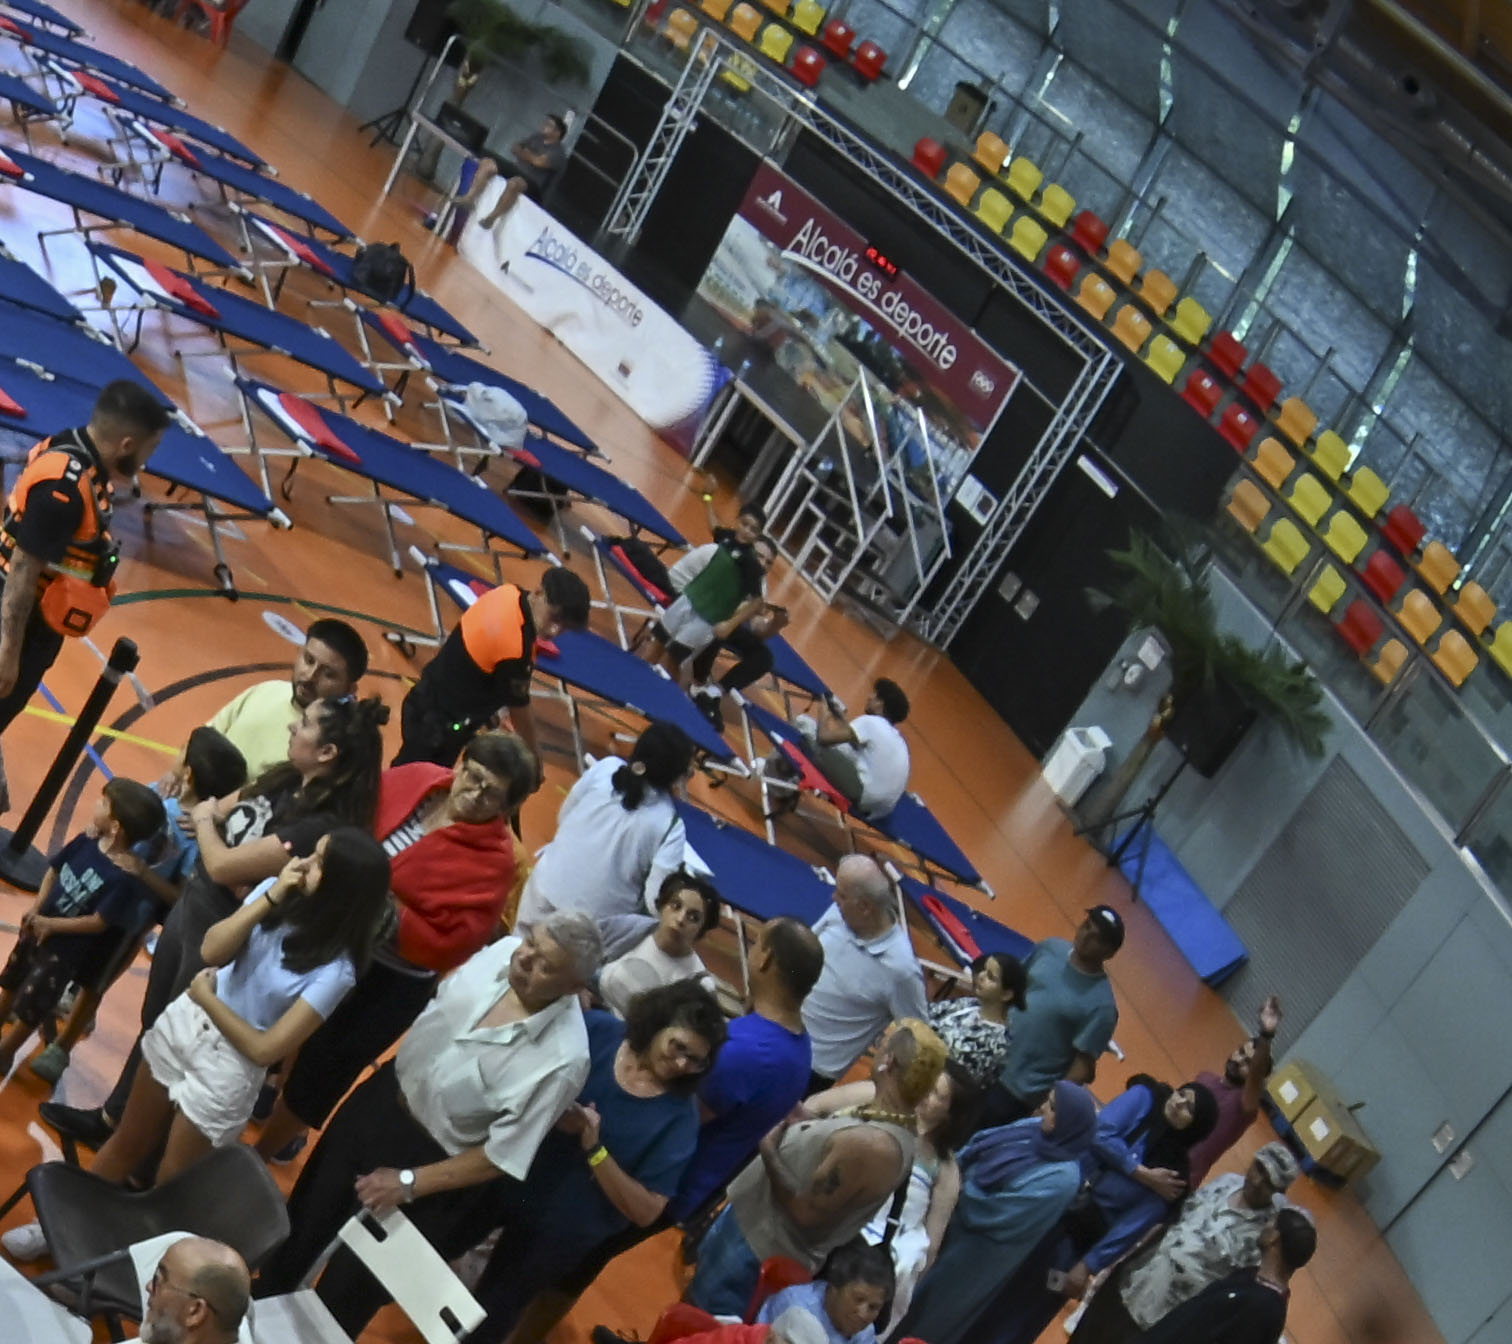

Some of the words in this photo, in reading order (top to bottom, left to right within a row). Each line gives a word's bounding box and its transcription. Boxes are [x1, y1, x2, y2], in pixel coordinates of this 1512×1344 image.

[785, 217, 859, 281] Alcalá
[857, 271, 882, 300] es
[882, 287, 958, 370] deporte
